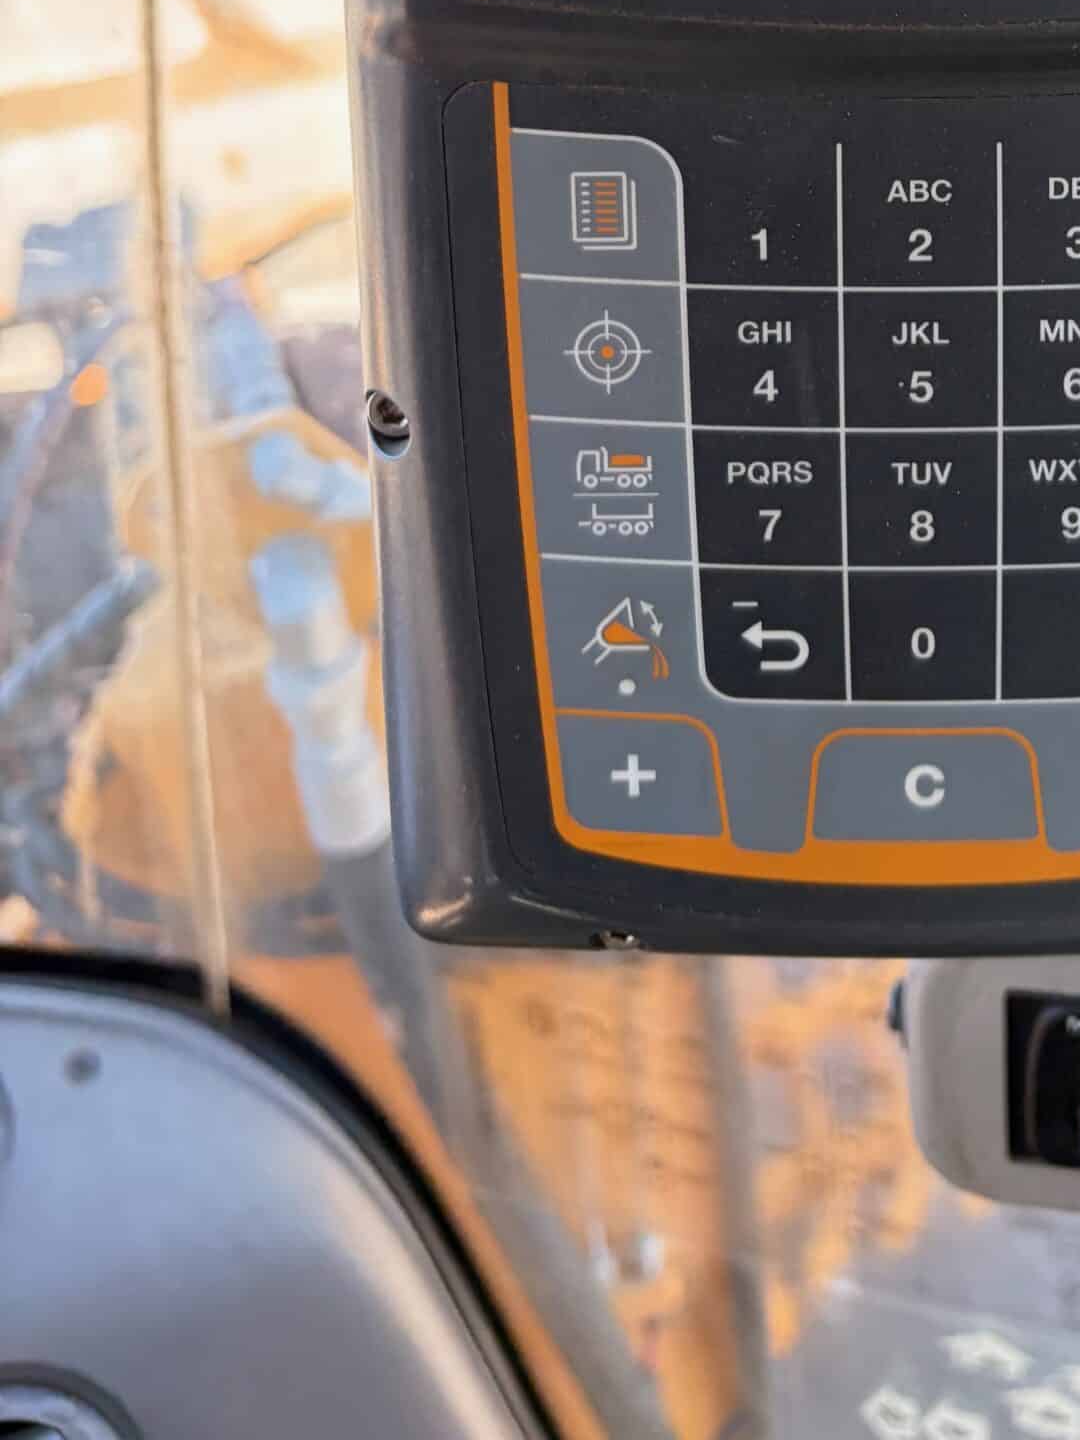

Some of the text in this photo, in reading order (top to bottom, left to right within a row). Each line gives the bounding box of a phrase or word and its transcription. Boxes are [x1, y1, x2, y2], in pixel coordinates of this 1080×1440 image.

[887, 179, 953, 204] ABC
[750, 227, 769, 262] 1
[907, 227, 934, 263] 2
[736, 320, 793, 345] GHI
[891, 320, 951, 346] JKL
[752, 369, 780, 403] 4
[908, 370, 935, 404] 5
[726, 459, 814, 486] PQRS
[890, 461, 954, 486] TUV
[758, 508, 783, 542] 7
[908, 509, 936, 543] 8
[910, 626, 936, 660] 0
[903, 764, 946, 808] C
